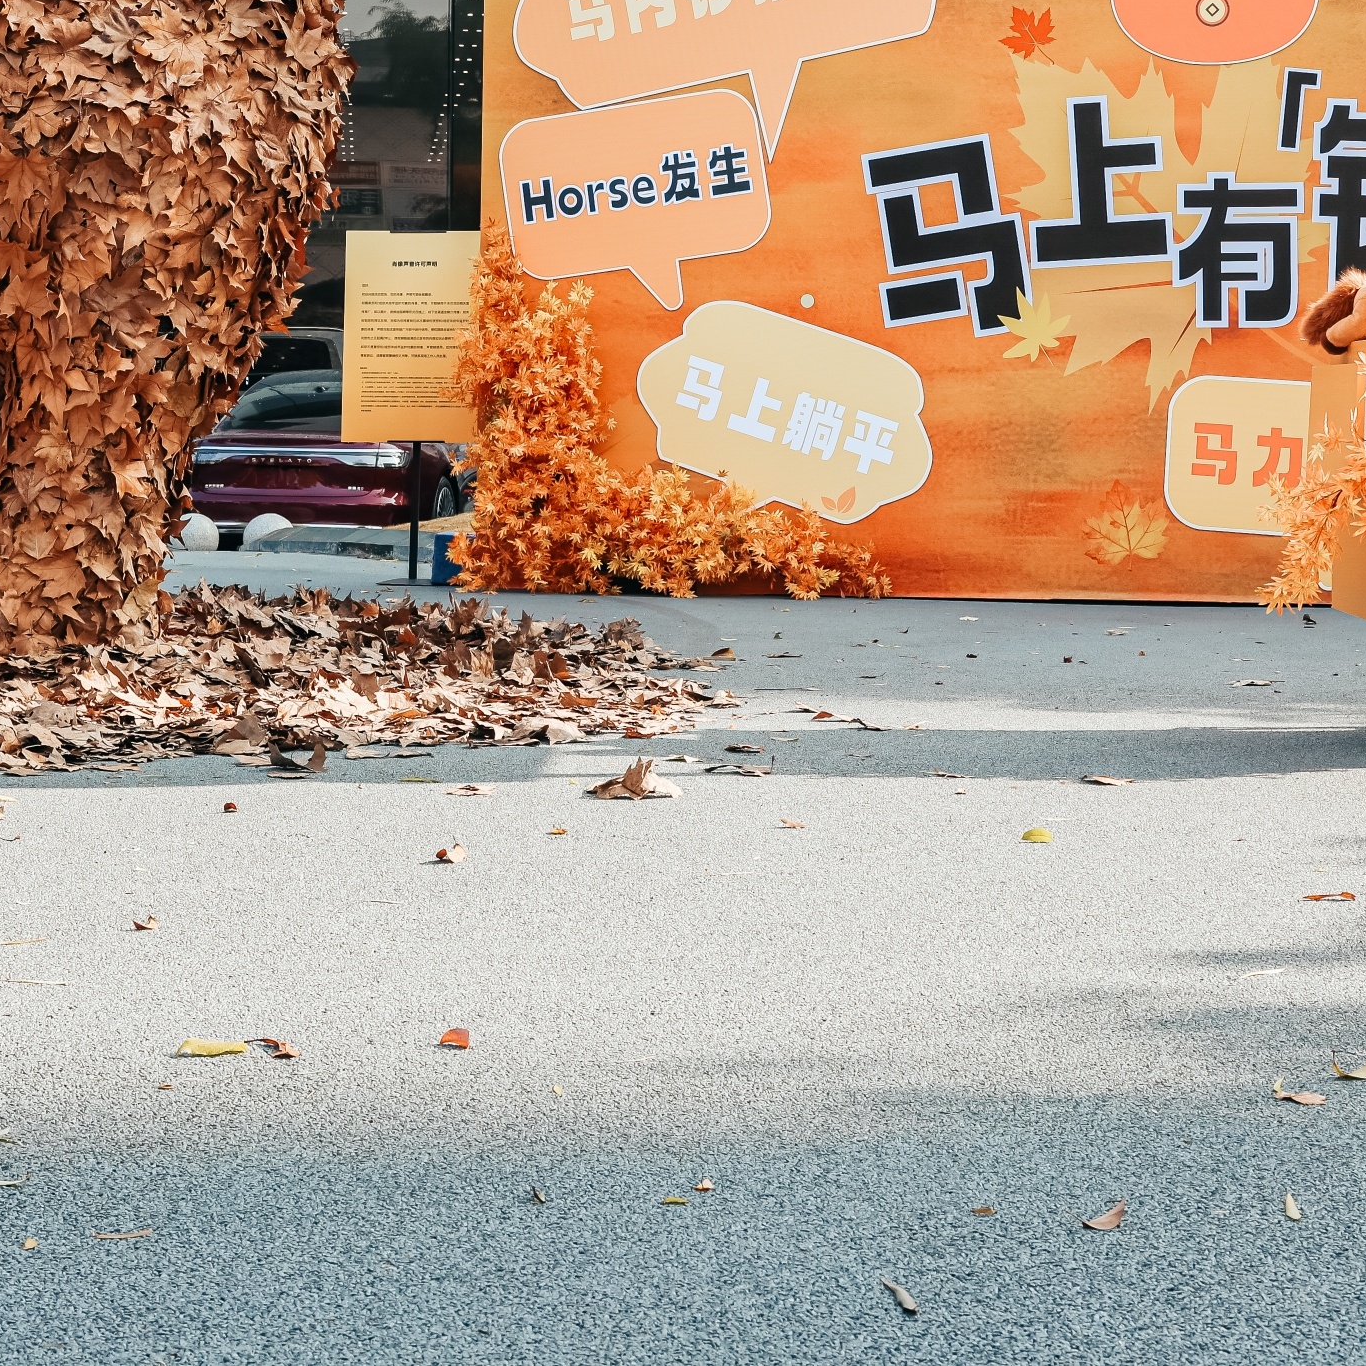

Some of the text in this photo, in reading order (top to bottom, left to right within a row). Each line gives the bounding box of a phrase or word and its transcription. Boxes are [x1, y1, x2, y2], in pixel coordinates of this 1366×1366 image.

[520, 143, 752, 224] Horse发生
[675, 355, 900, 477] 马上躺平
[1191, 422, 1304, 489] 马力
